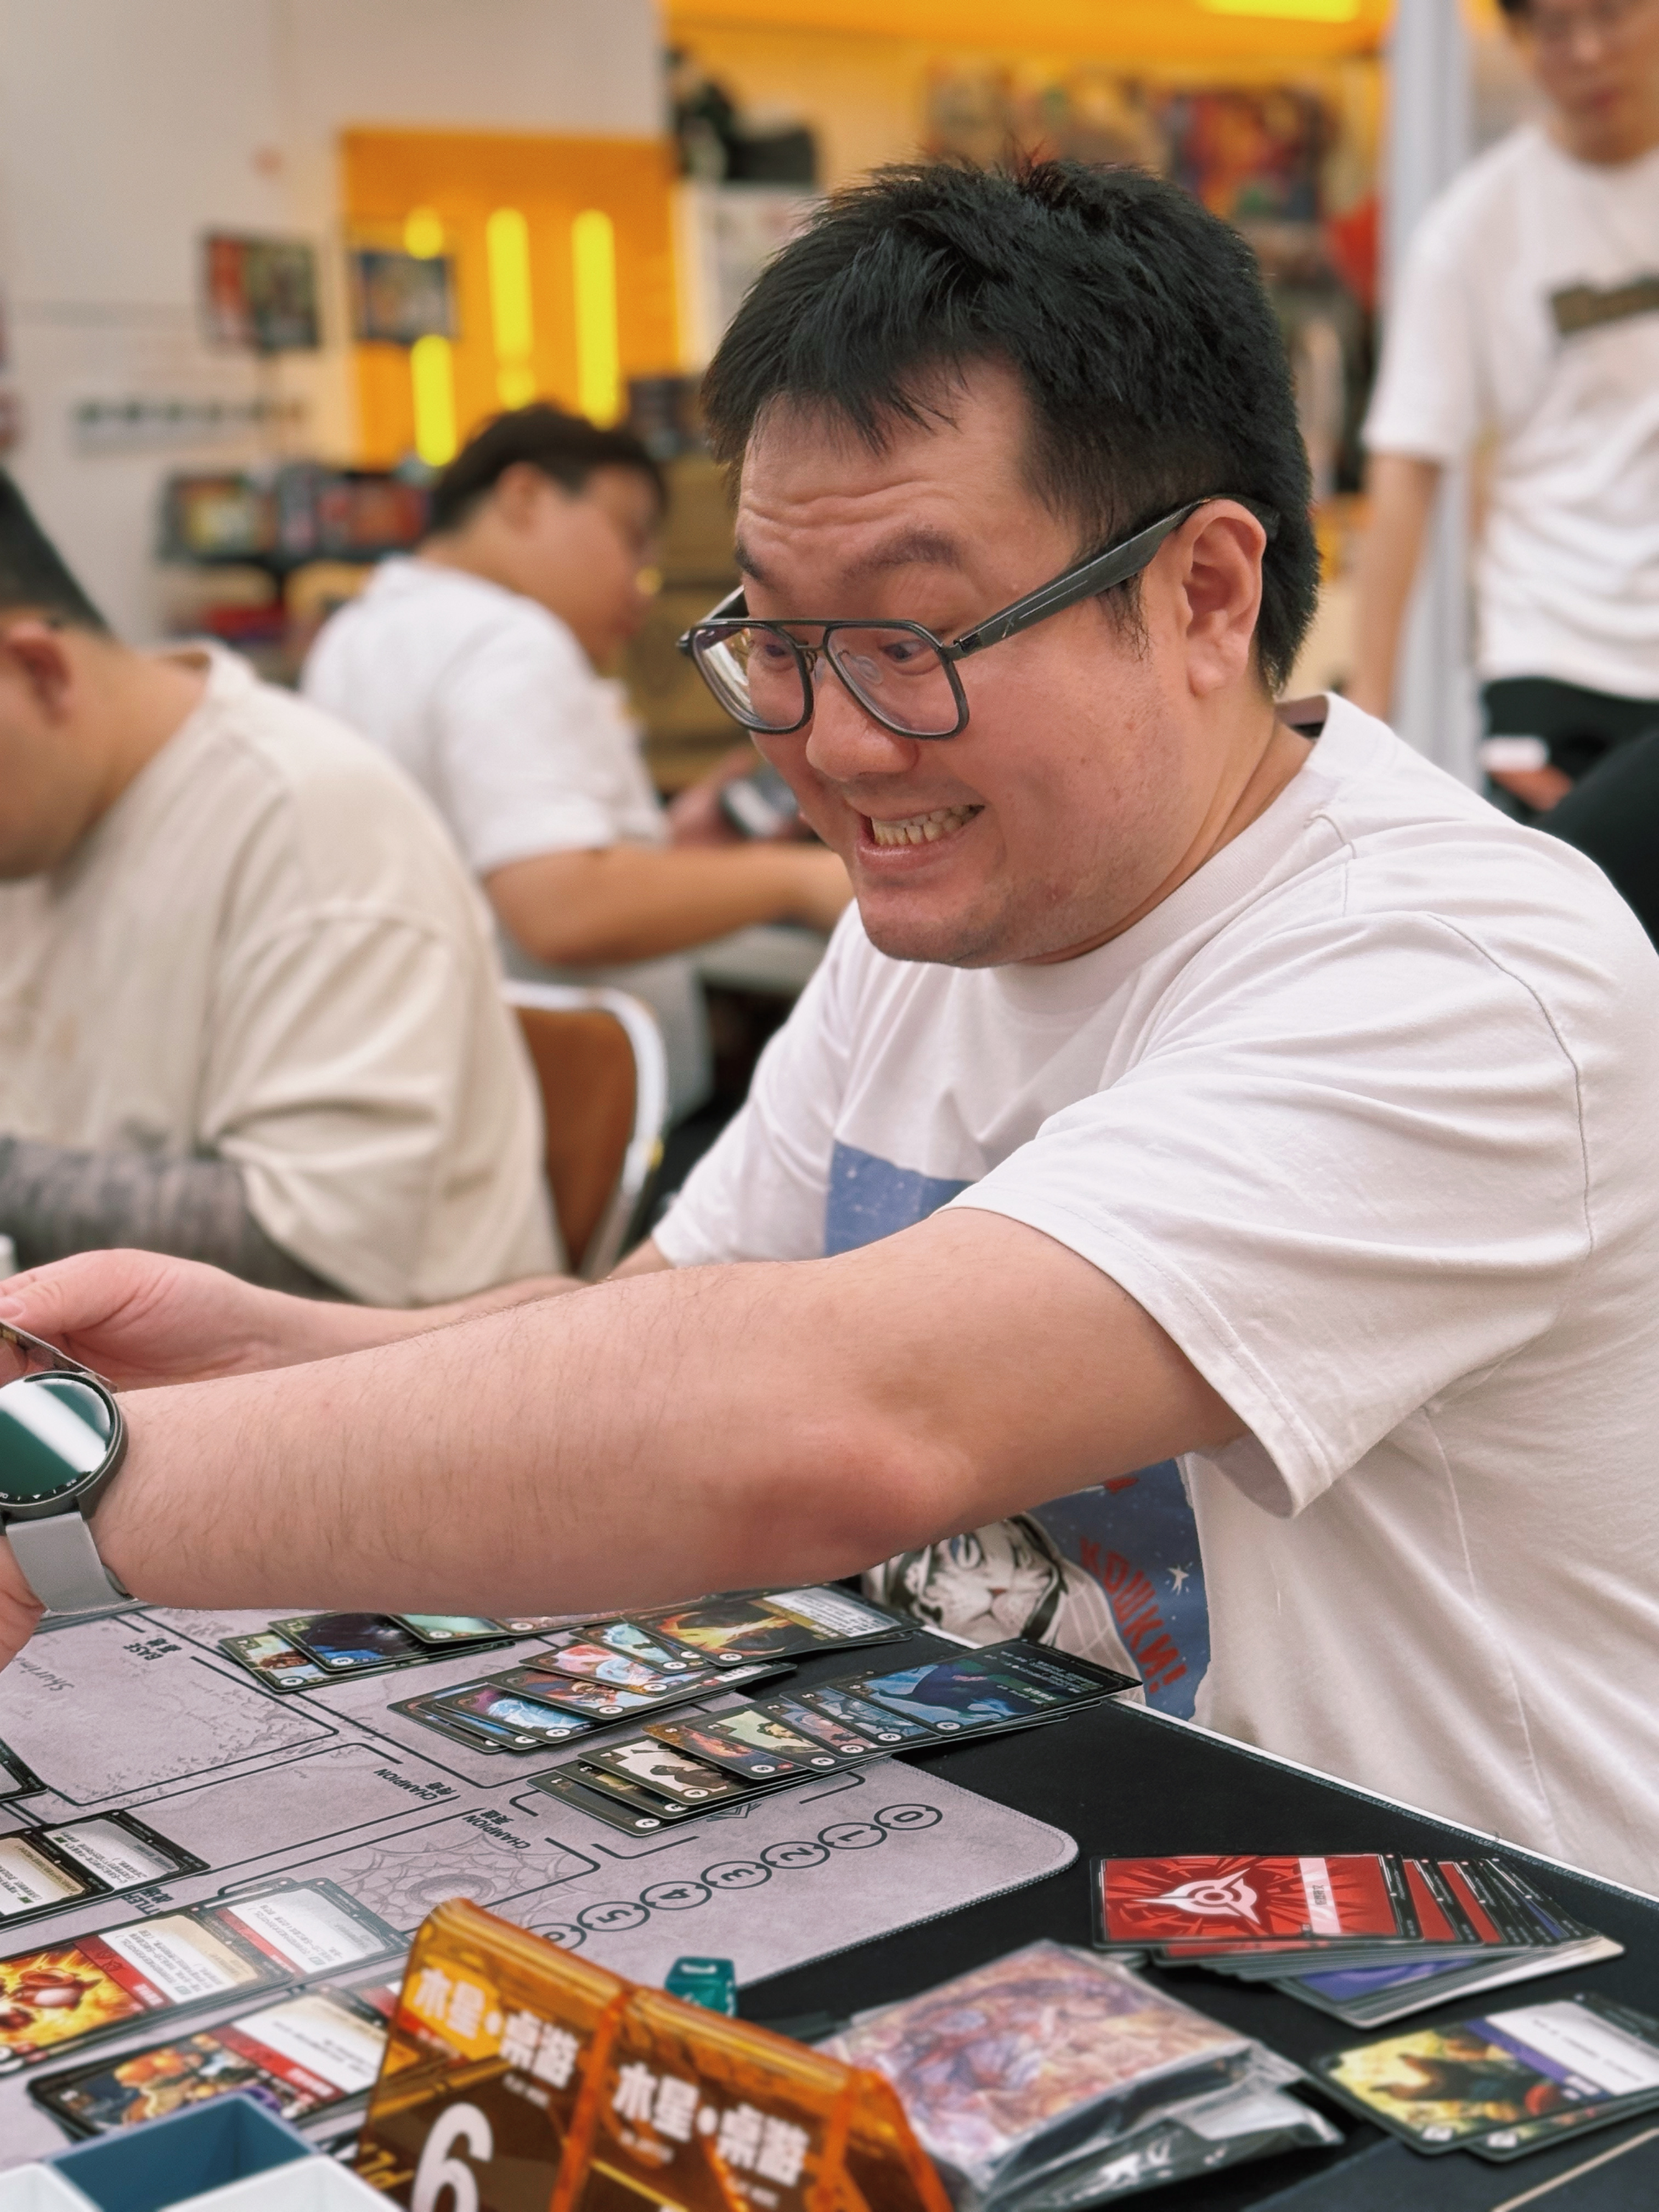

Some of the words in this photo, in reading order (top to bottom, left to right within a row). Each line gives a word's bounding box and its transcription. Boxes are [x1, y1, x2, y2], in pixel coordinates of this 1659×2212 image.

[1080, 1534, 1187, 1694] КОШКИ!
[123, 1643, 163, 1661] BASE
[374, 1769, 438, 1800] CHAMPION
[480, 1810, 515, 1825] 英雄
[893, 1811, 924, 1822] 0
[462, 1815, 531, 1849] CHAMPION
[837, 1830, 865, 1842] 1
[780, 1847, 815, 1861] 2
[721, 1869, 755, 1882] 3
[659, 1888, 691, 1900] 4
[596, 1909, 633, 1923] 5
[411, 2102, 494, 2212] 6
